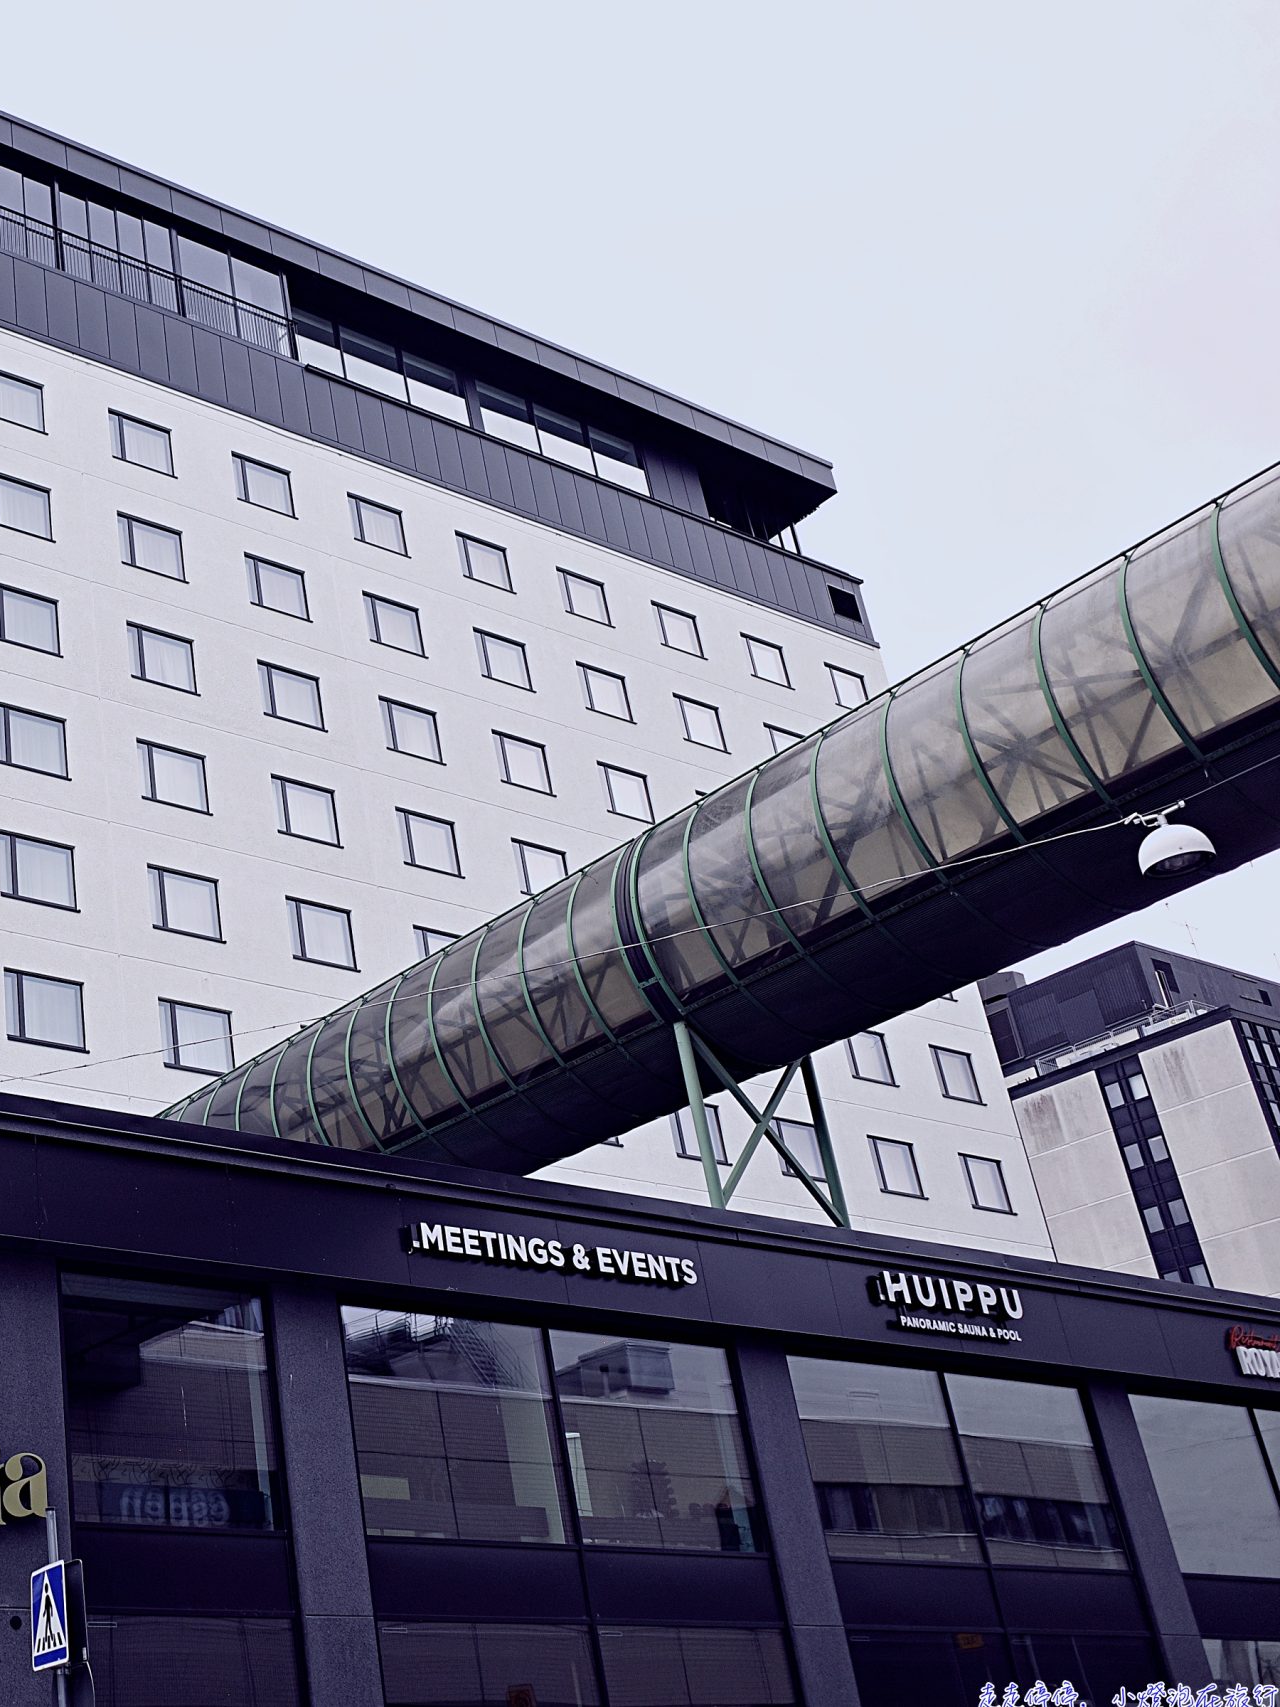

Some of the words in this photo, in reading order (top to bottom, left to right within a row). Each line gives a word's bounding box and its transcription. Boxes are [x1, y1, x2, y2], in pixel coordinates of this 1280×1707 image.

[420, 1222, 565, 1267] MEETINGS
[572, 1243, 591, 1272] &
[595, 1246, 698, 1286] EVENTS
[883, 1271, 1024, 1320] HUIPPU
[900, 1315, 957, 1333] PANORAMIC
[958, 1323, 988, 1337] SAUNA
[989, 1327, 997, 1338] &
[997, 1328, 1022, 1342] POOL
